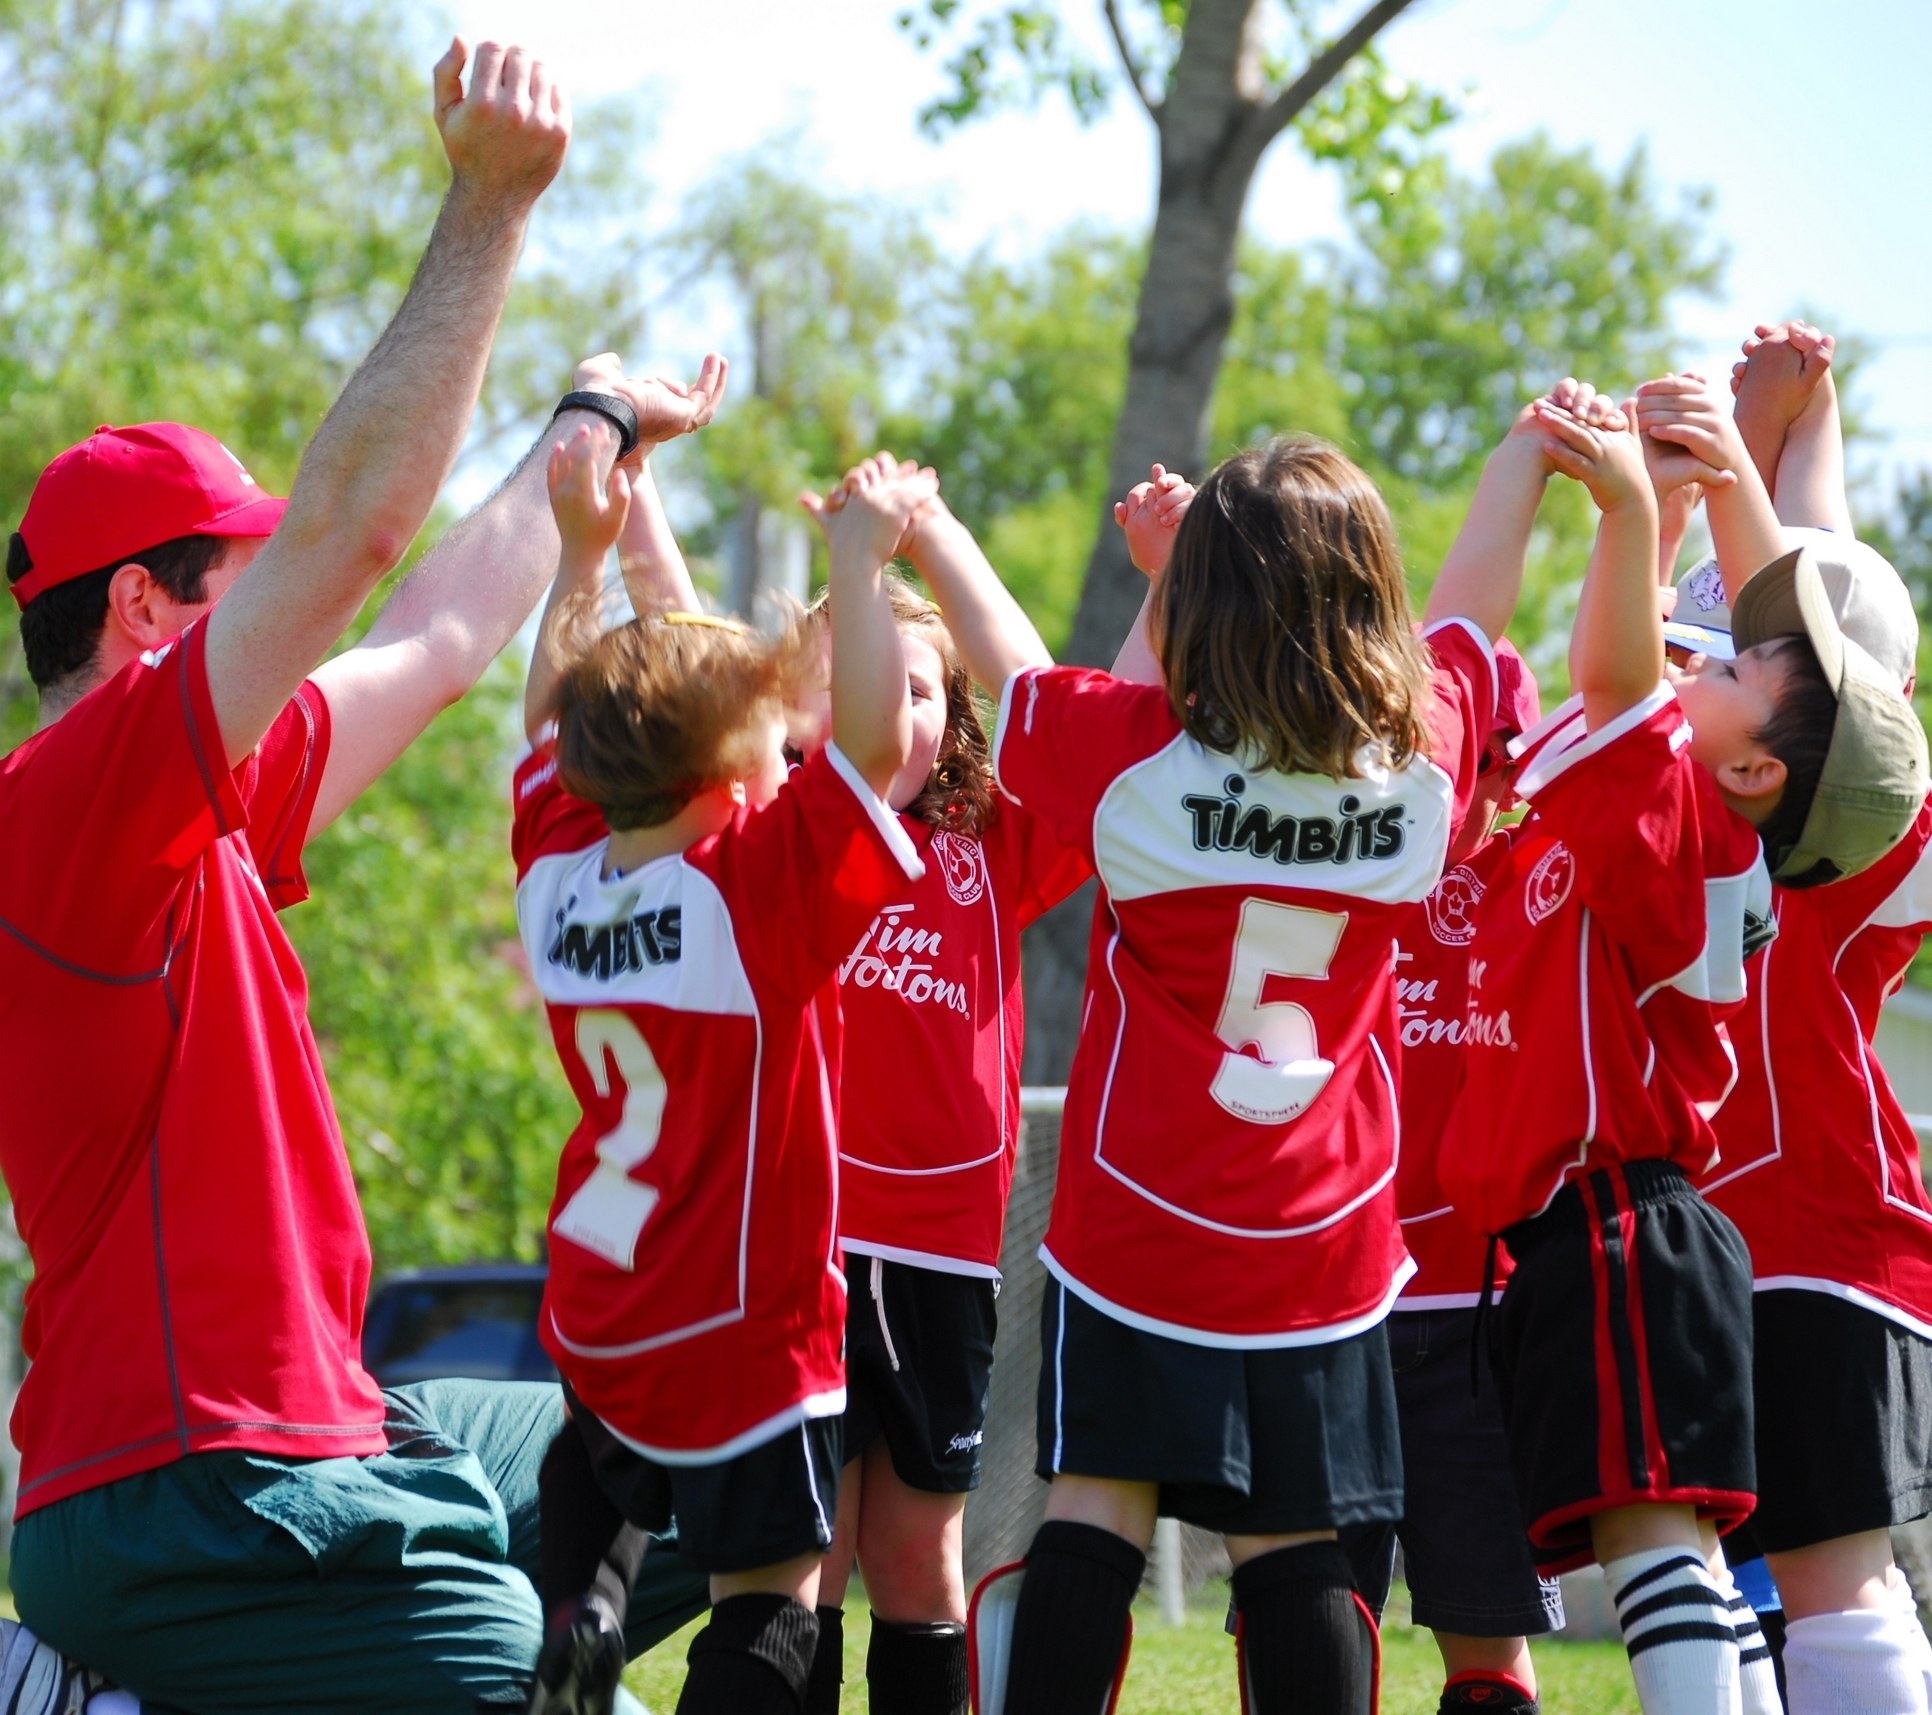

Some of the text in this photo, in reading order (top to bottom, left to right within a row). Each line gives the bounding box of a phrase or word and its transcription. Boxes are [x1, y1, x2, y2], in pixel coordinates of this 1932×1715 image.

[963, 882, 981, 900] CLUB
[1432, 921, 1465, 942] SOCCER
[1209, 896, 1349, 1126] 5
[553, 1004, 668, 1273] 2
